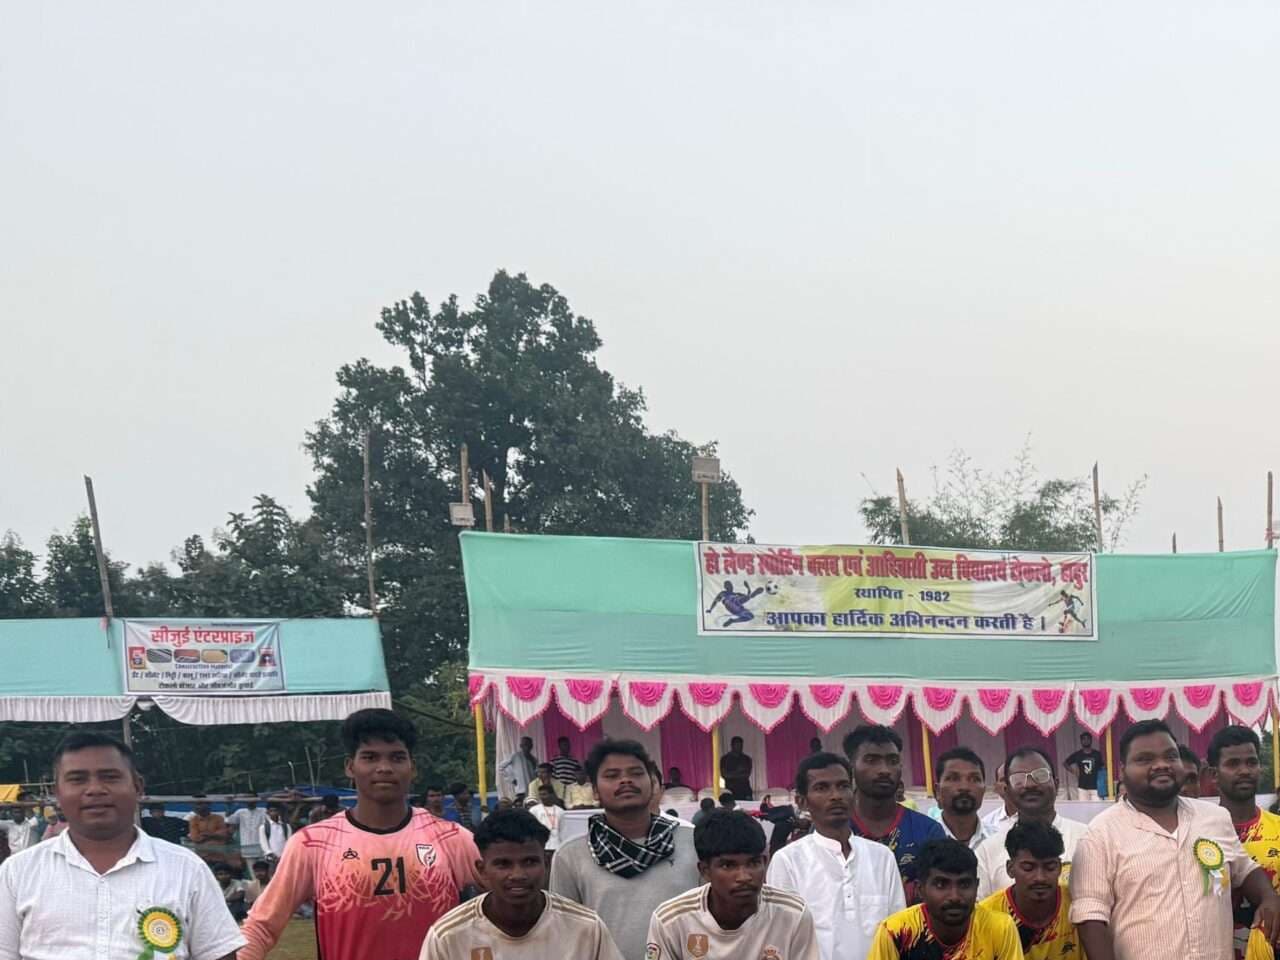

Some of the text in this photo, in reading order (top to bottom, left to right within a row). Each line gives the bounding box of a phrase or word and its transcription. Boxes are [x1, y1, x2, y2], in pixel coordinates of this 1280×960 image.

[854, 585, 903, 600] स्थापित
[920, 590, 950, 602] 1982
[766, 611, 825, 626] आपका
[832, 609, 885, 627] हार्दिक
[889, 610, 968, 628] अभिनन्दन
[371, 857, 406, 896] 21
